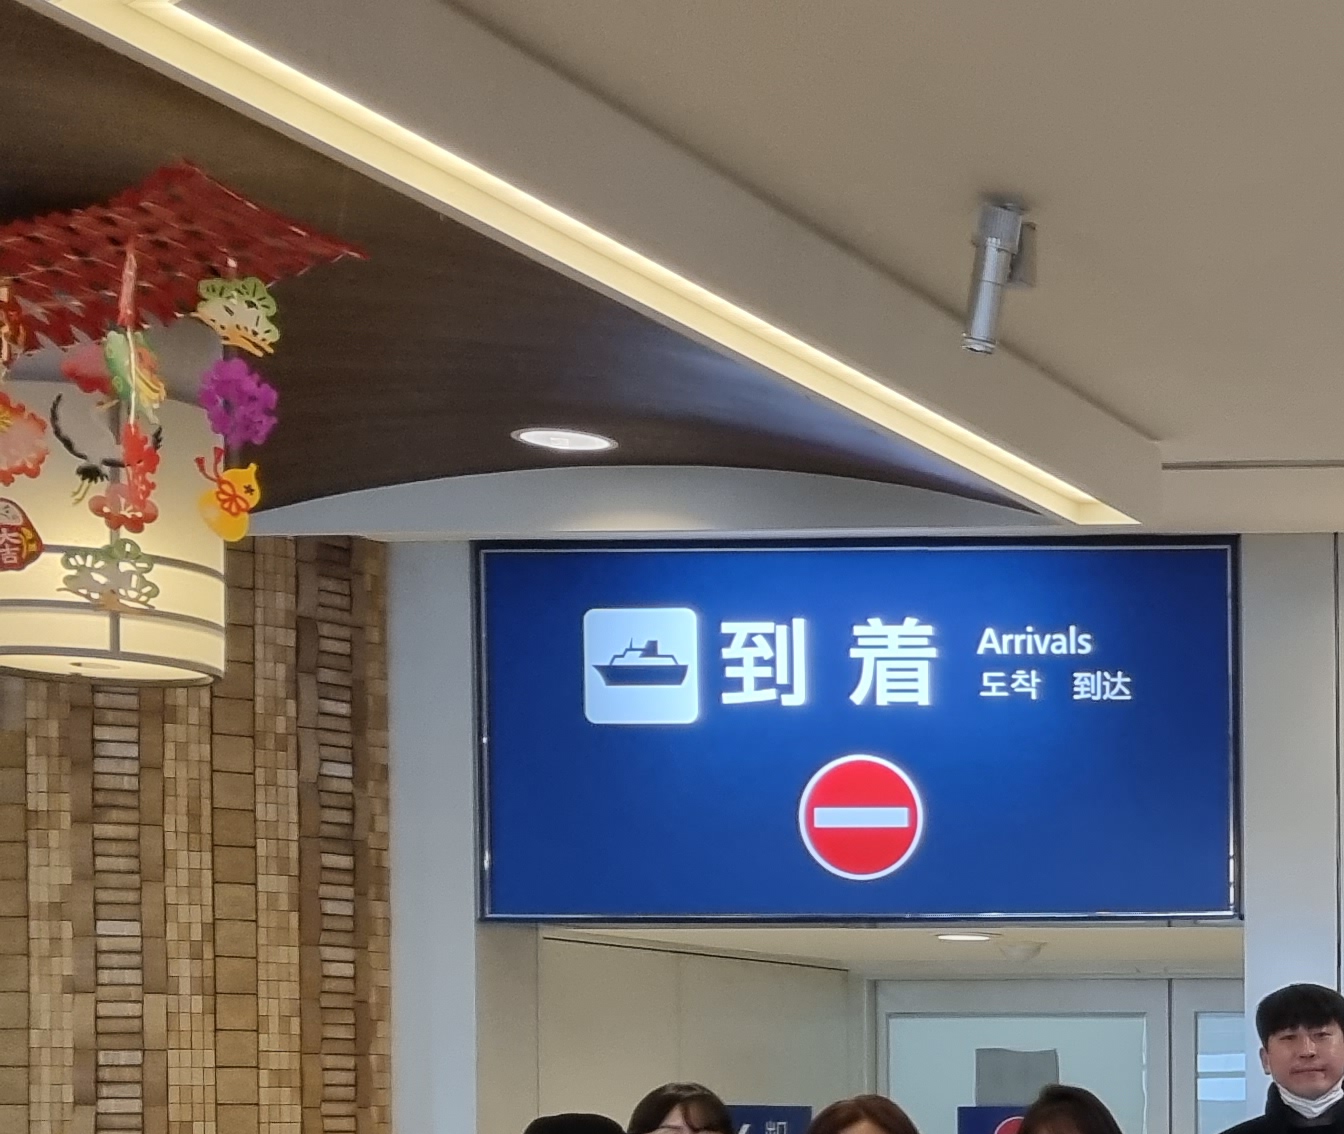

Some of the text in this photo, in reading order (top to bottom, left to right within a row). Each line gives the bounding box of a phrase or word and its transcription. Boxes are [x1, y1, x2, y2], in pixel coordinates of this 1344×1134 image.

[976, 624, 1093, 656] Arrivals
[979, 669, 1133, 701] 도착 到达
